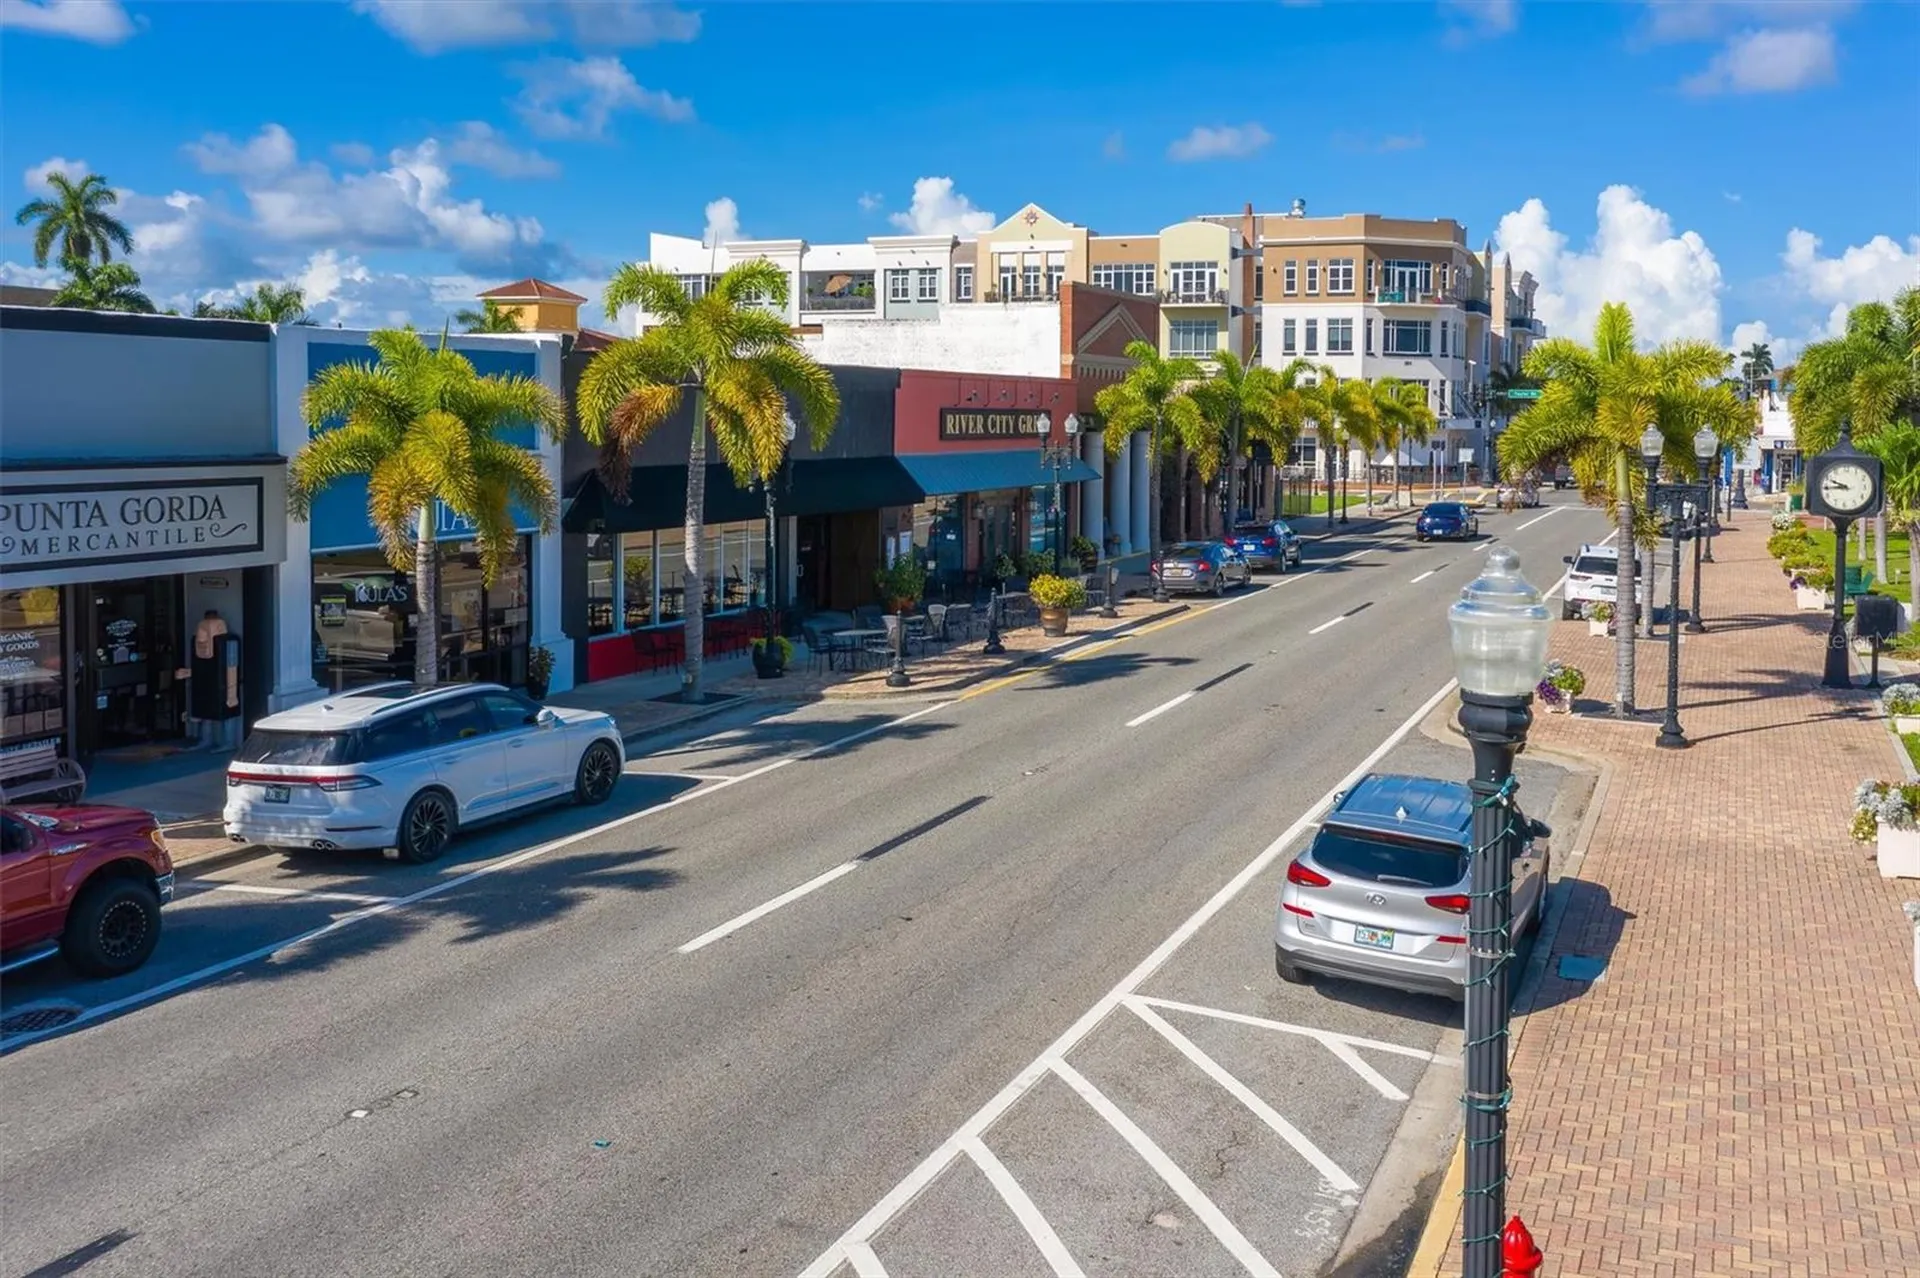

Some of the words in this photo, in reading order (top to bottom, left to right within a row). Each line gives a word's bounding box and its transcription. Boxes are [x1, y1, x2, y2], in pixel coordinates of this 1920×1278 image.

[946, 414, 985, 434] RIVER
[988, 414, 1016, 434] CITY
[1018, 414, 1039, 434] GRI
[0, 499, 108, 534] PUNTA
[120, 494, 228, 526] GORDA
[21, 526, 206, 556] MERCANTILE
[6, 640, 40, 652] GOODS
